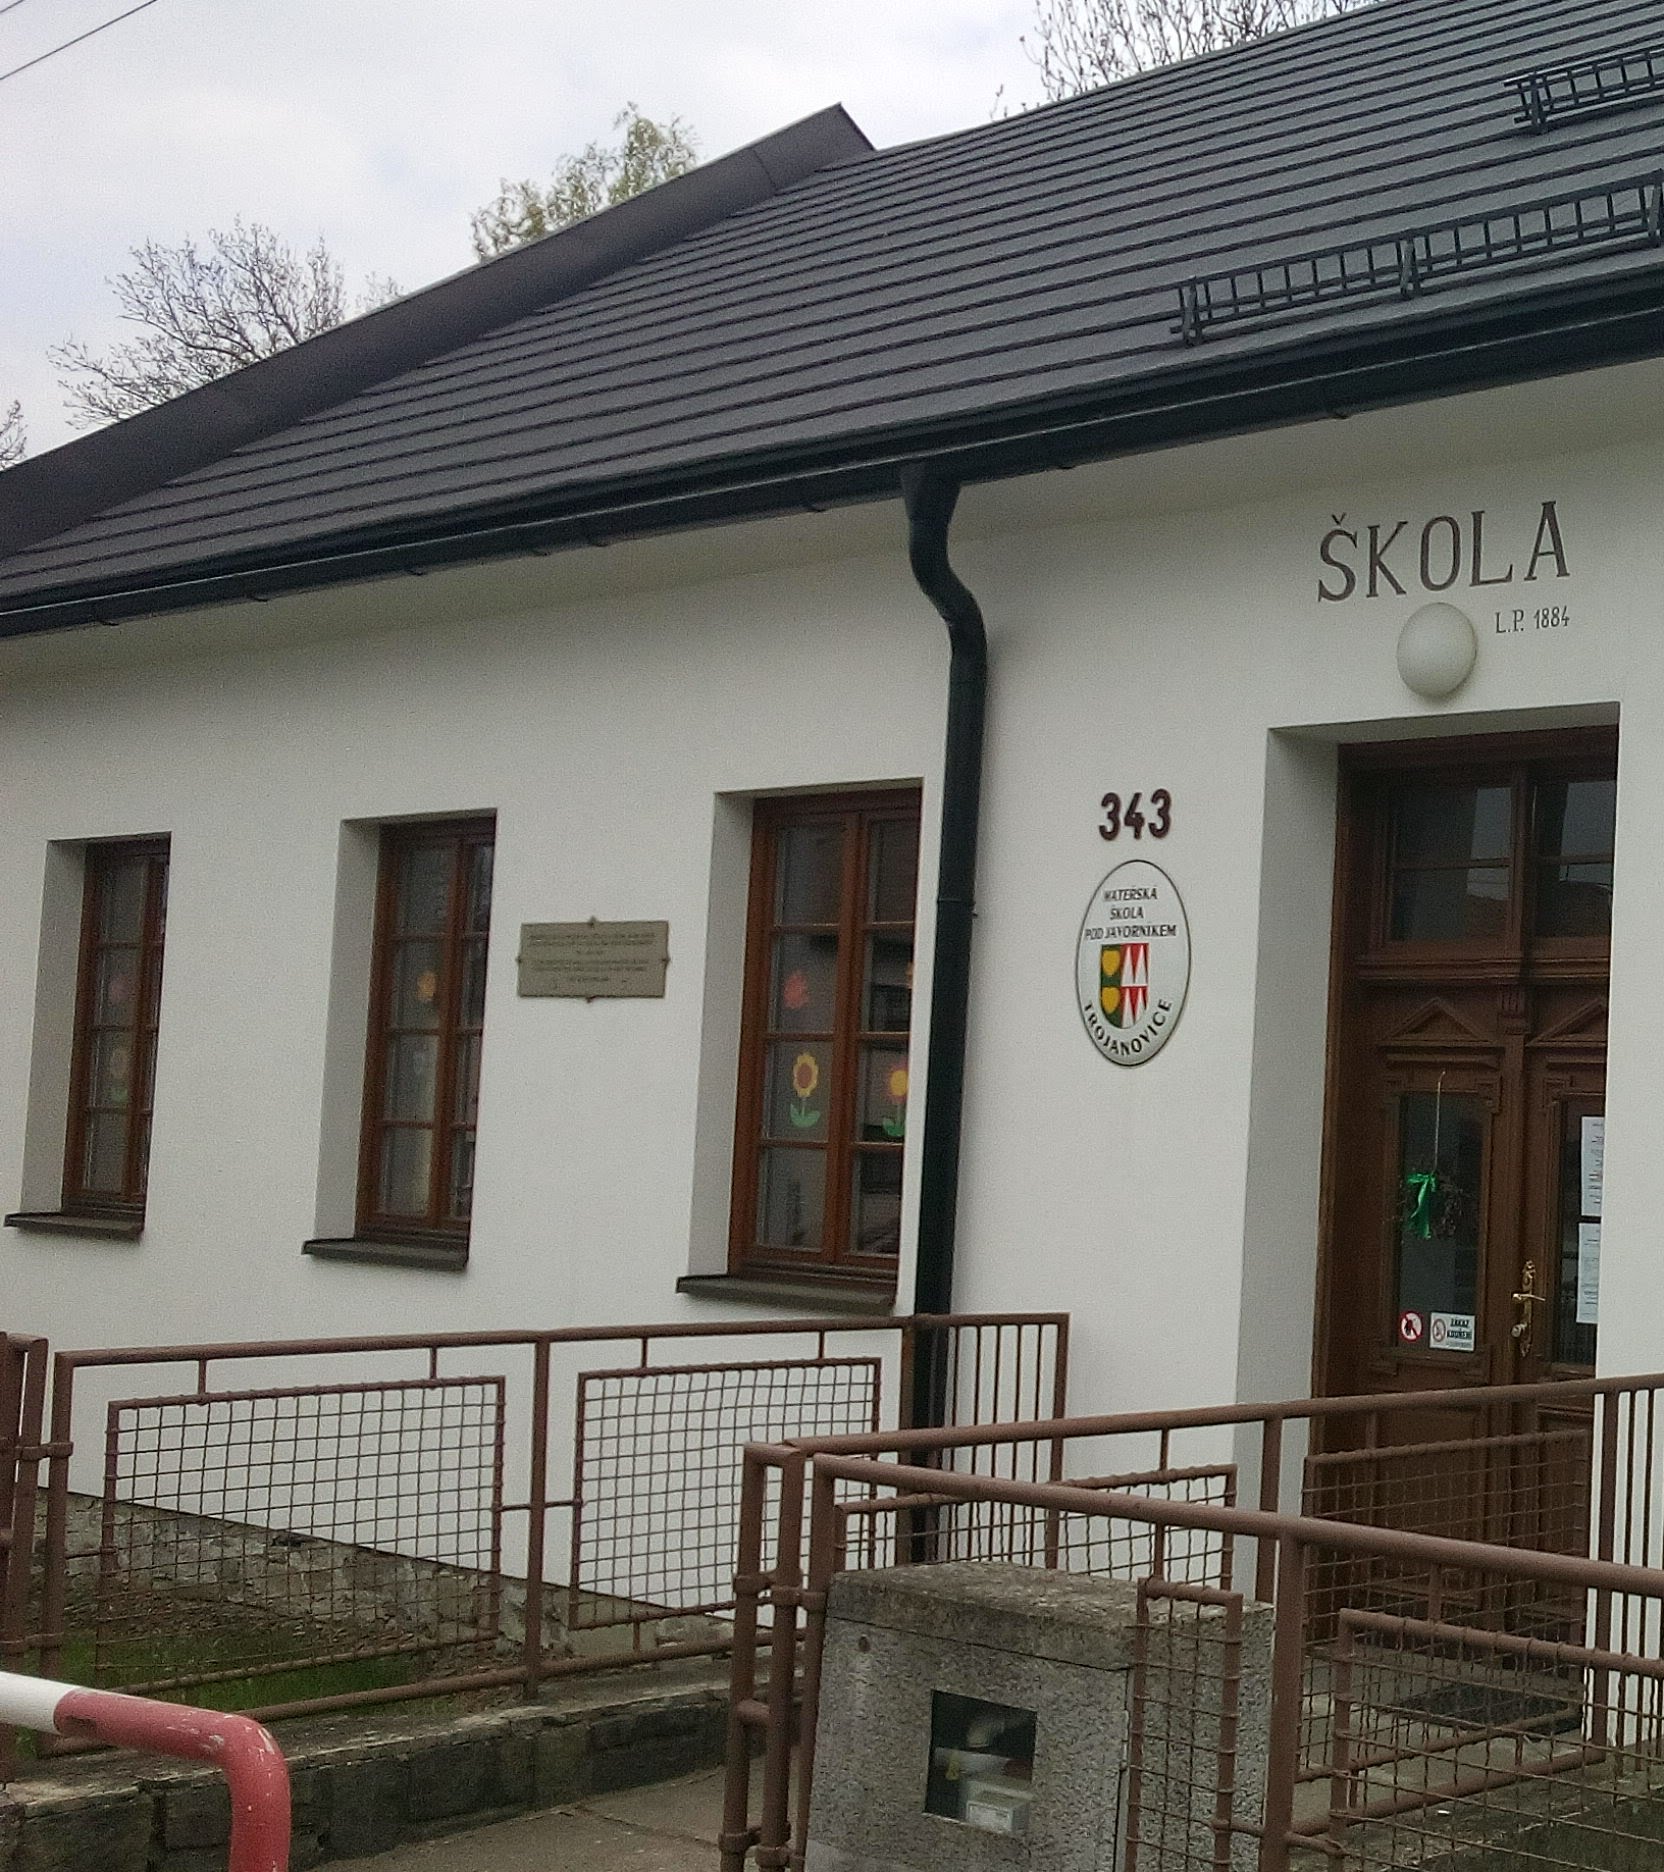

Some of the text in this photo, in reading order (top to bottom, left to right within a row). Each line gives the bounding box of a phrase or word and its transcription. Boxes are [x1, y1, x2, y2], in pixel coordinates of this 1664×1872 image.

[1317, 500, 1570, 602] ŠKOLA
[1533, 604, 1570, 630] 1884
[1098, 788, 1172, 842] 343
[1109, 904, 1144, 921] ŠKOLA
[1085, 928, 1104, 940] POD
[1083, 998, 1172, 1056] TROJANOVICE
